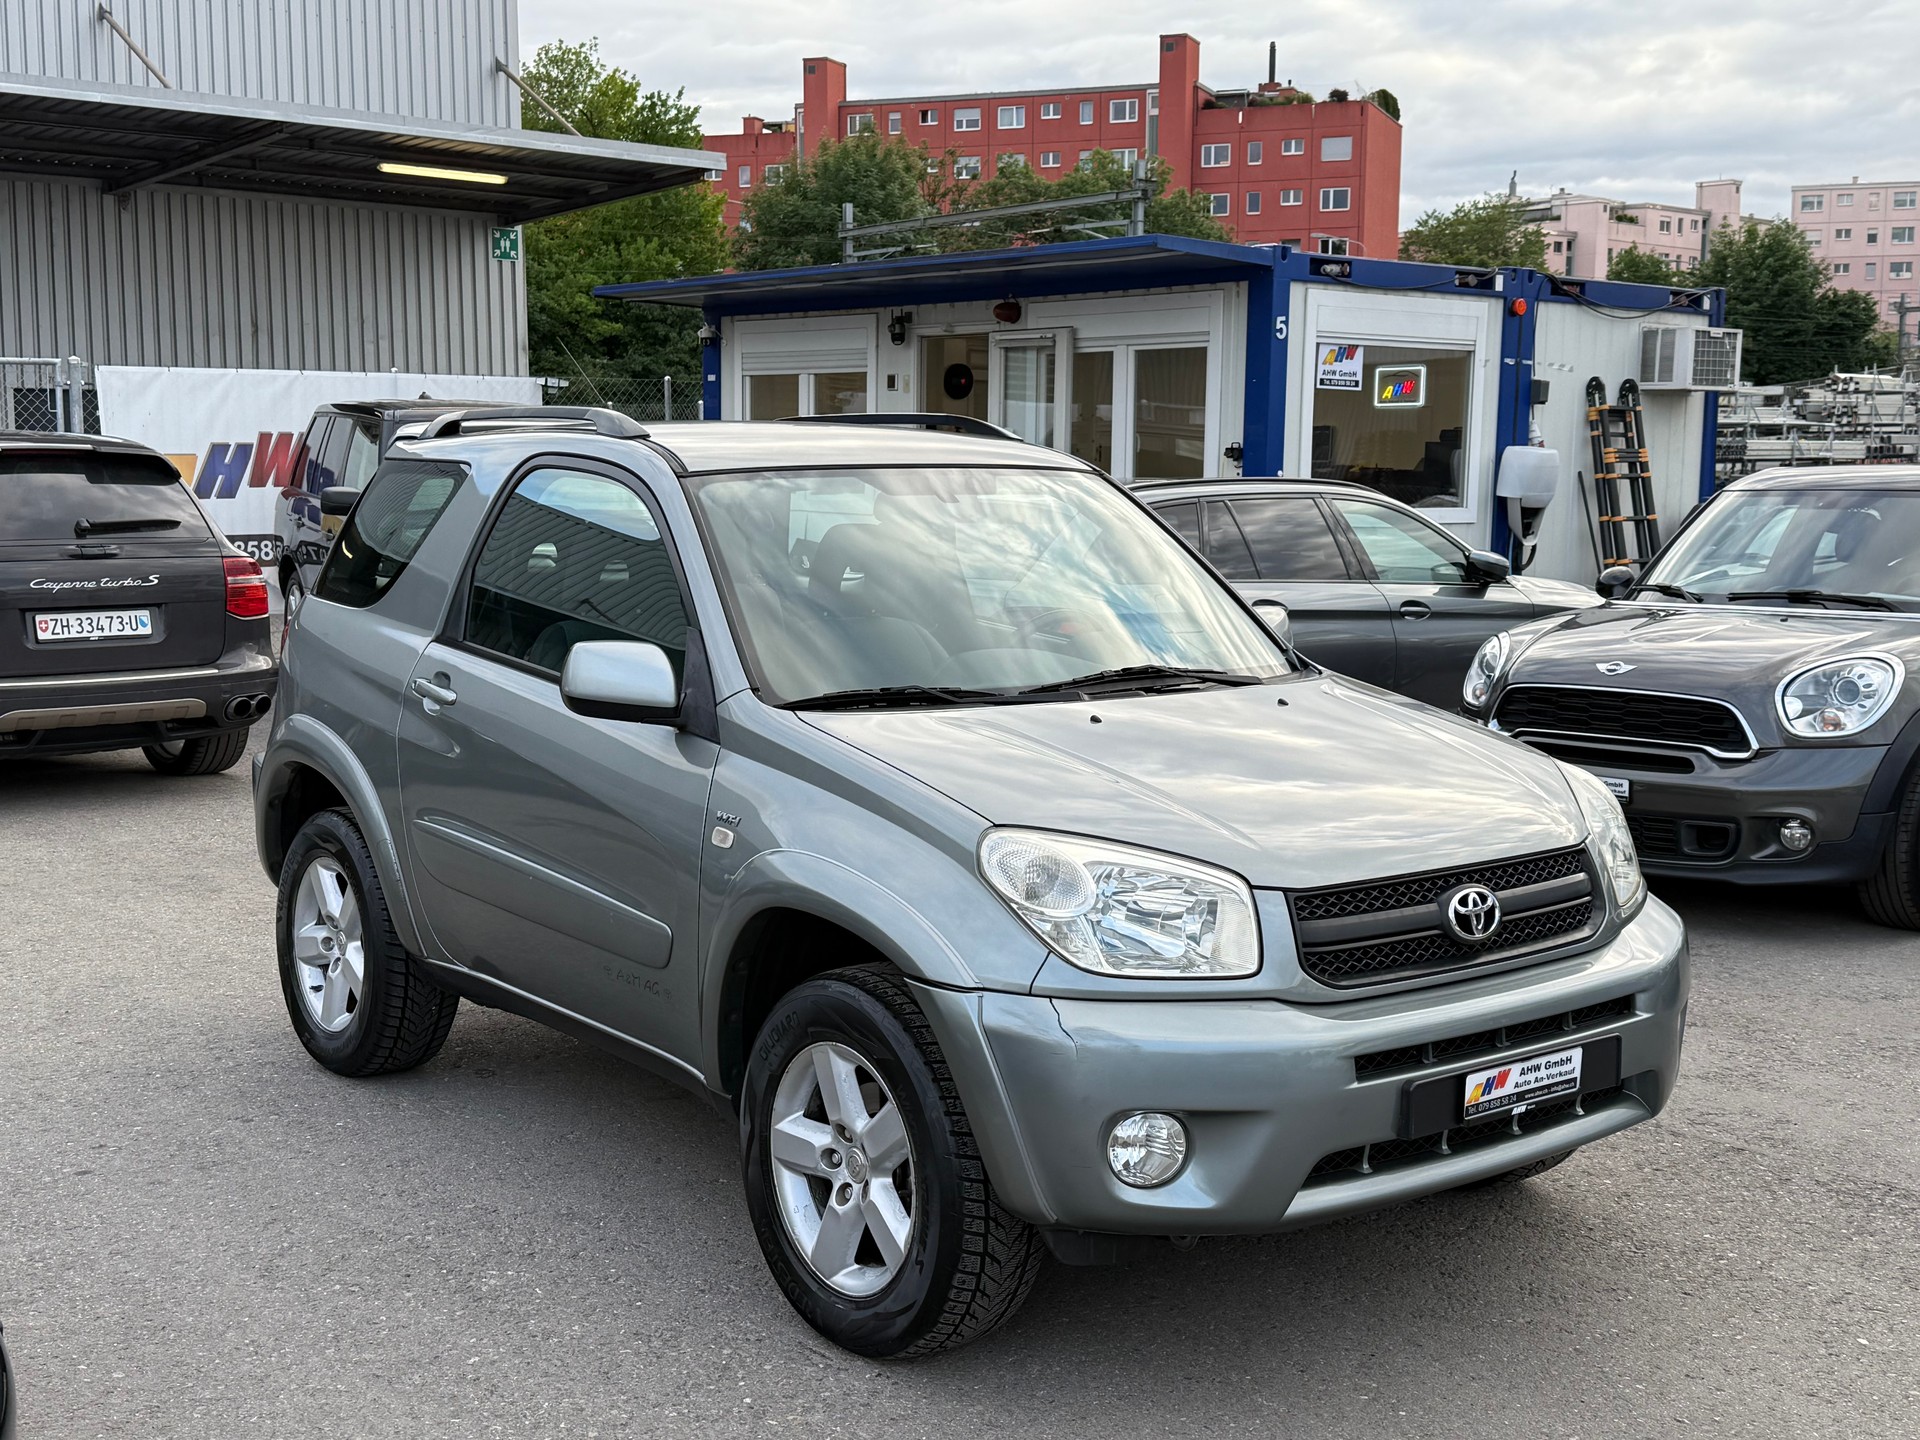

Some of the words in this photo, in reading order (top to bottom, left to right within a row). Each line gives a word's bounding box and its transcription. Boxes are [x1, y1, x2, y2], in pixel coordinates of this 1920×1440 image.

[1275, 316, 1287, 340] 5
[1322, 344, 1359, 366] AHW
[1322, 369, 1337, 377] AHW
[1338, 370, 1357, 378] GmbH
[1382, 380, 1415, 399] AHW
[164, 431, 305, 499] HW
[30, 578, 97, 594] Cayenne
[1519, 1062, 1542, 1077] AHW
[1544, 1055, 1572, 1071] GmbH
[1466, 1068, 1512, 1105] AHW
[1514, 1078, 1532, 1090] Auto
[1534, 1067, 1576, 1084] An-Verkauf
[1468, 1106, 1478, 1114] Tel.
[1478, 1102, 1489, 1112] 079
[1490, 1099, 1501, 1110] 858
[1501, 1096, 1509, 1106] 58
[1510, 1094, 1517, 1104] 24
[1511, 1104, 1527, 1116] AHW
